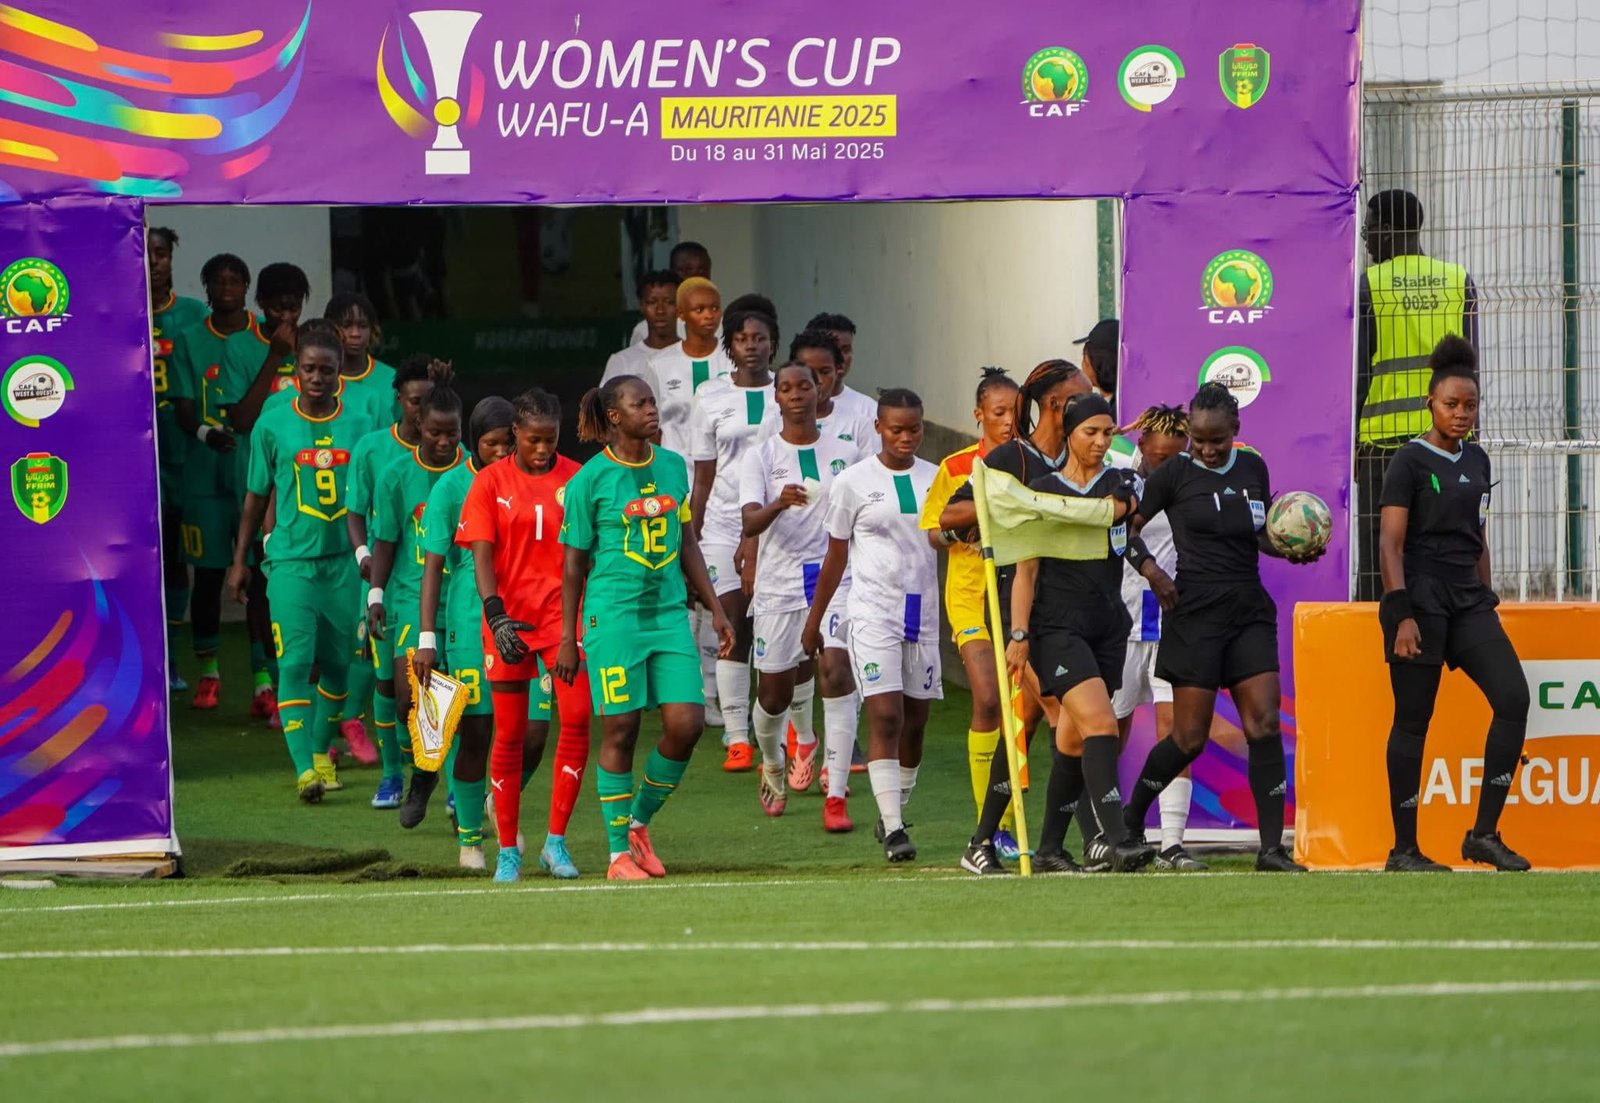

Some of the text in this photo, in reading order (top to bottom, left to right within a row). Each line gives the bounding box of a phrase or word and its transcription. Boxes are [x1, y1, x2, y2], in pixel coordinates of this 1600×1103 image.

[493, 37, 901, 90] WOMEN'S CUP
[497, 101, 649, 138] WAFU-A
[671, 105, 886, 129] MAURITANIE 2025
[1030, 103, 1080, 117] CAF
[671, 142, 884, 162] Du 18 au 31 Mai 2025
[1392, 275, 1448, 287] Stadier
[7, 317, 62, 334] CAF
[1208, 309, 1263, 324] CAF
[315, 469, 338, 505] 9
[534, 504, 543, 540] 1
[640, 516, 668, 553] 12
[181, 523, 203, 558] 10
[829, 613, 840, 638] 6
[600, 666, 630, 704] 12
[923, 666, 934, 690] 3
[1539, 681, 1600, 709] CA
[1419, 757, 1600, 806] AFGU
